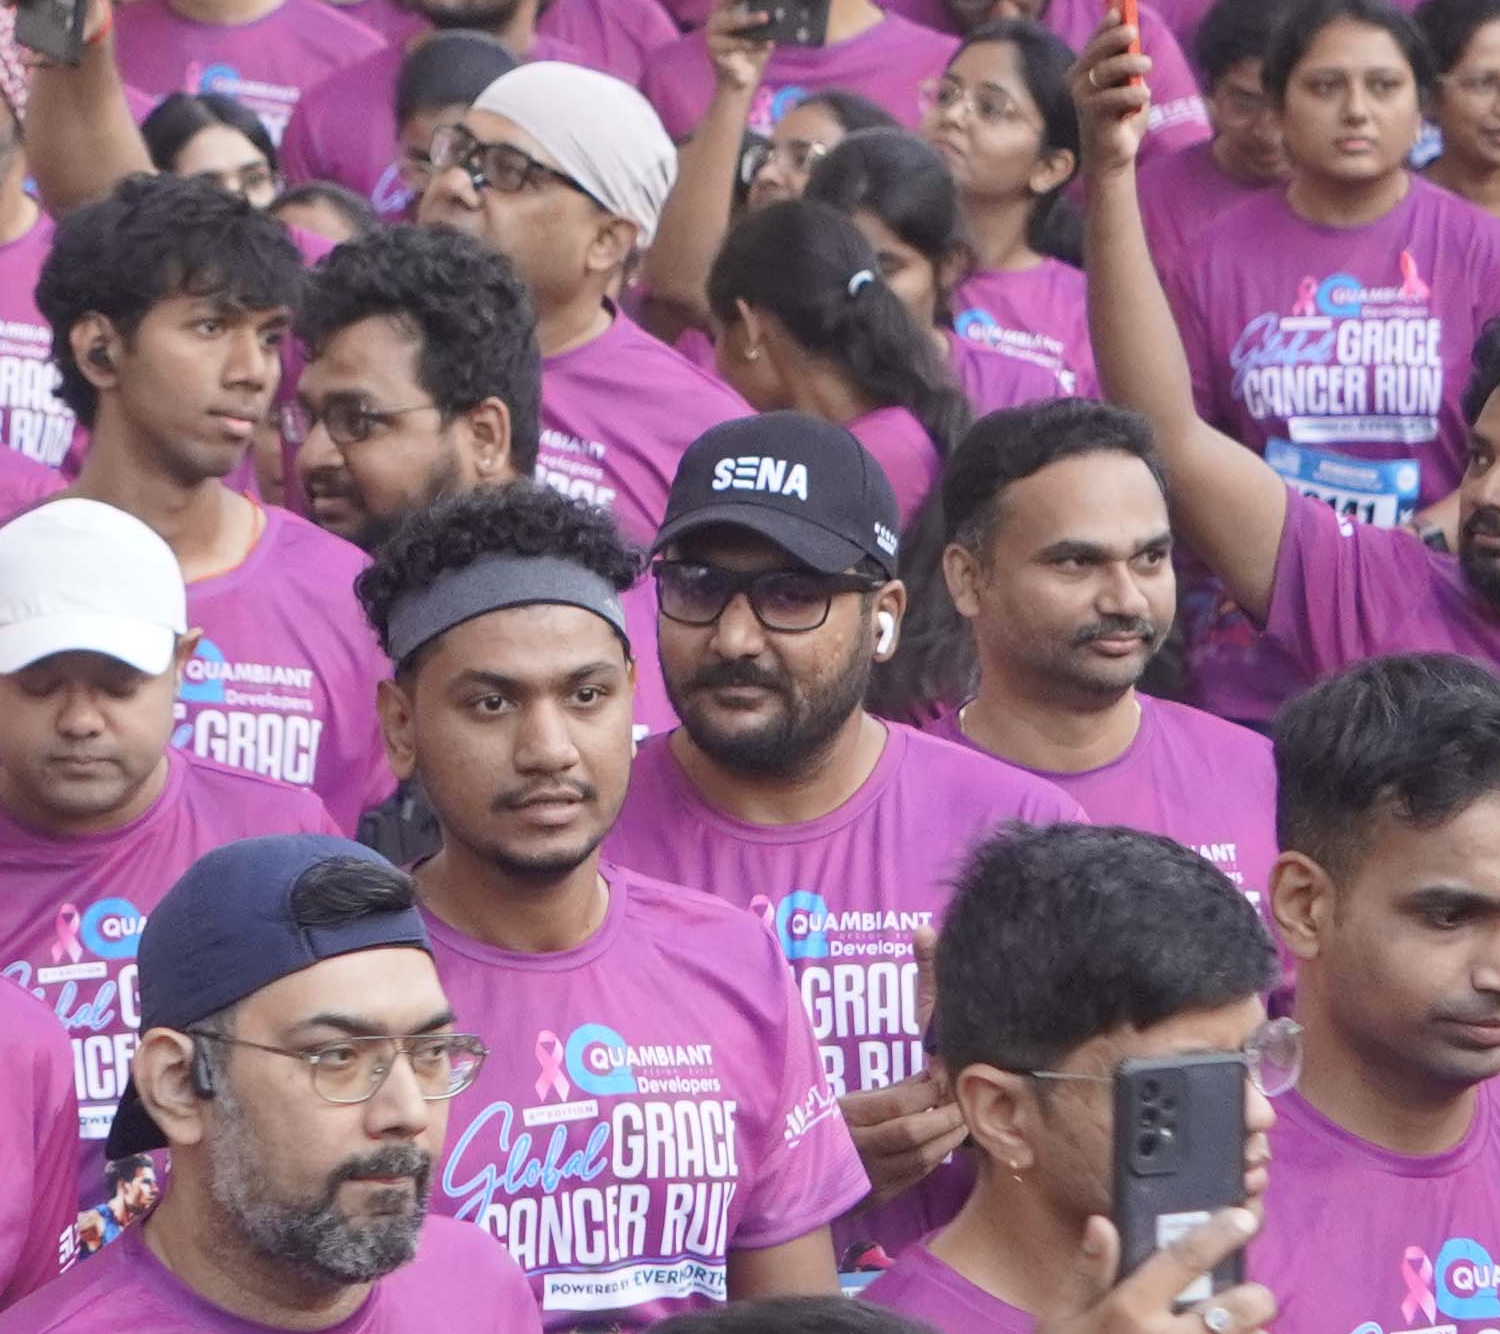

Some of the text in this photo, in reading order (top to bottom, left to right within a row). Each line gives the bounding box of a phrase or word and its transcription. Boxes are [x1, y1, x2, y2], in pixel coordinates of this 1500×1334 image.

[1231, 313, 1442, 397] Global GRACE
[1243, 366, 1443, 419] CANCER RUN
[711, 456, 808, 501] SENA
[186, 660, 313, 690] QUAMBIANT
[224, 689, 314, 713] Developers
[791, 912, 932, 937] QUAMBIANT
[829, 940, 917, 959] Develope
[803, 963, 922, 1038] GRAC
[589, 1046, 713, 1072] QUAMBIANT
[636, 1076, 721, 1097] Developers
[442, 1101, 738, 1223] Global GRACE
[485, 1188, 648, 1269] CANCER
[551, 1283, 617, 1295] POWERED
